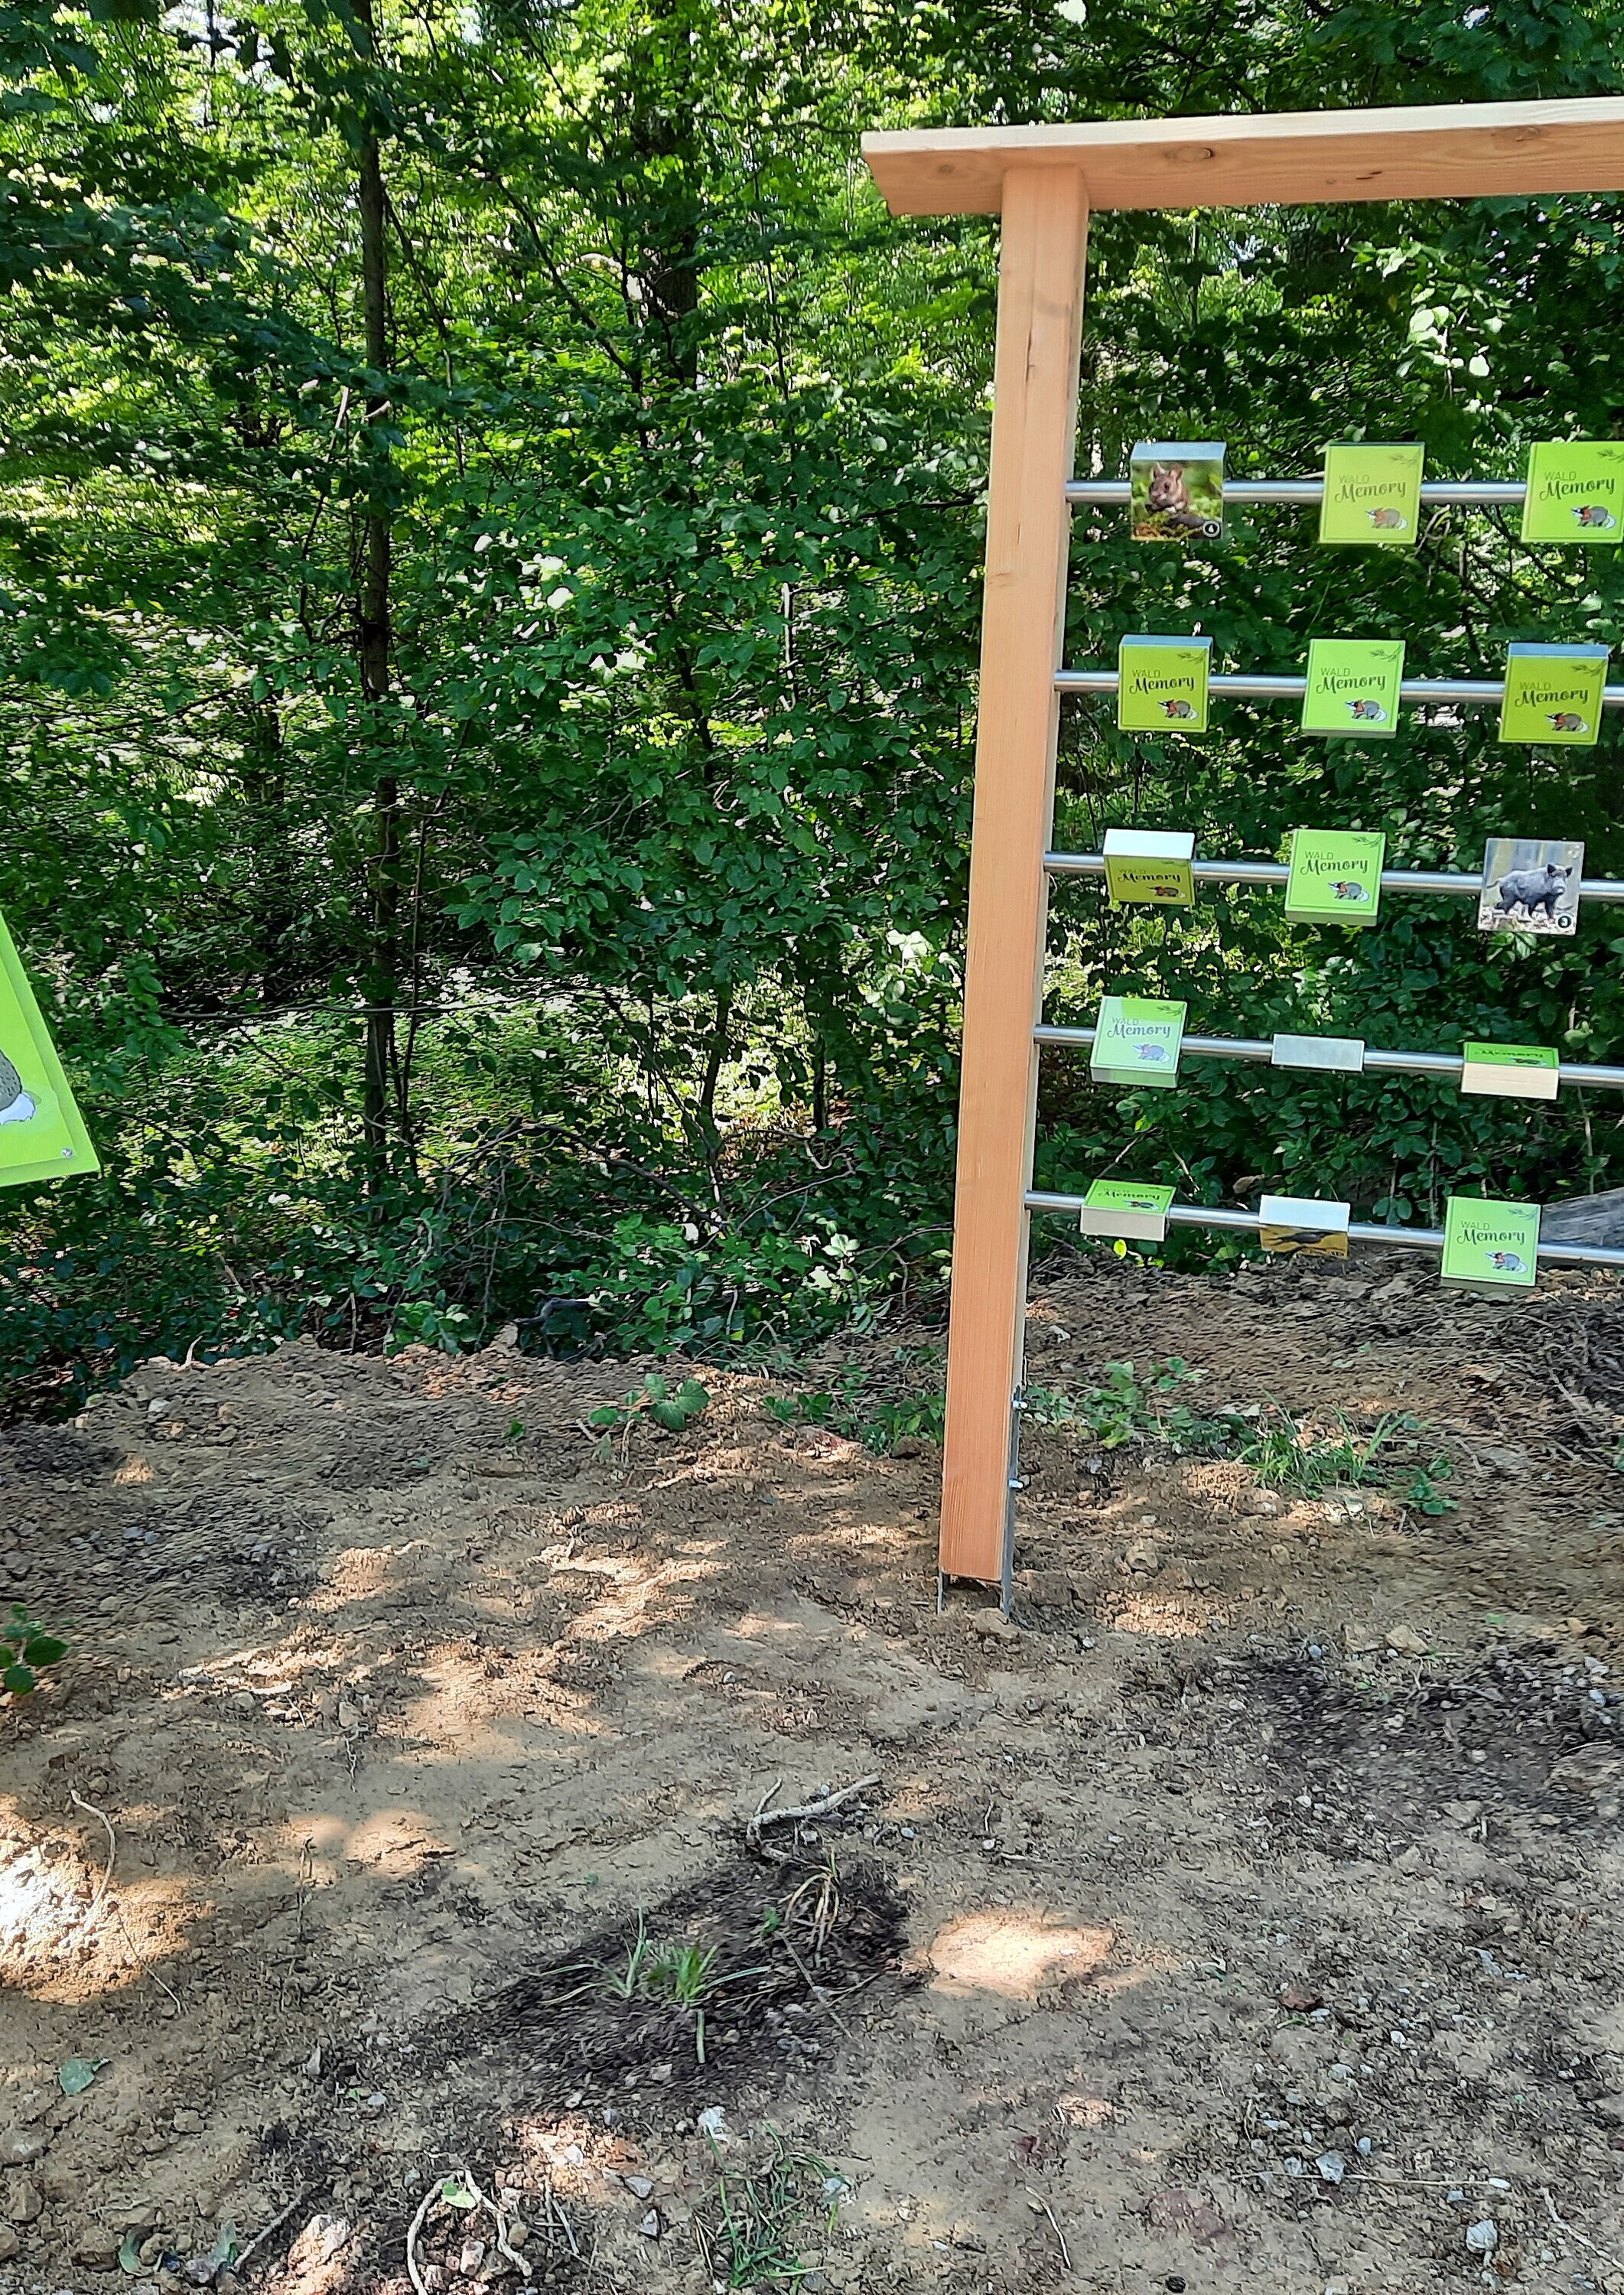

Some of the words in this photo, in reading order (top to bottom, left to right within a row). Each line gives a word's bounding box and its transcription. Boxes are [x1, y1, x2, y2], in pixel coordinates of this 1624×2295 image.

[1339, 474, 1370, 484] WALD
[1544, 471, 1577, 481] WALD
[1335, 481, 1406, 503] Memory
[1539, 477, 1615, 500] Memory
[1132, 669, 1160, 678] WALD
[1320, 667, 1350, 676] WALD
[1129, 676, 1195, 695] Memory
[1316, 674, 1385, 694] Memory
[1519, 682, 1551, 691] WALD
[1515, 688, 1589, 708] Memory
[1304, 851, 1334, 860] WALD
[1300, 858, 1368, 876] Memory
[1118, 873, 1181, 884] Memory
[1112, 1017, 1139, 1025] WALD
[1107, 1024, 1170, 1039] Memory
[1098, 1191, 1160, 1201] Memory
[1461, 1220, 1490, 1230] WALD
[1456, 1229, 1525, 1246] Memory
